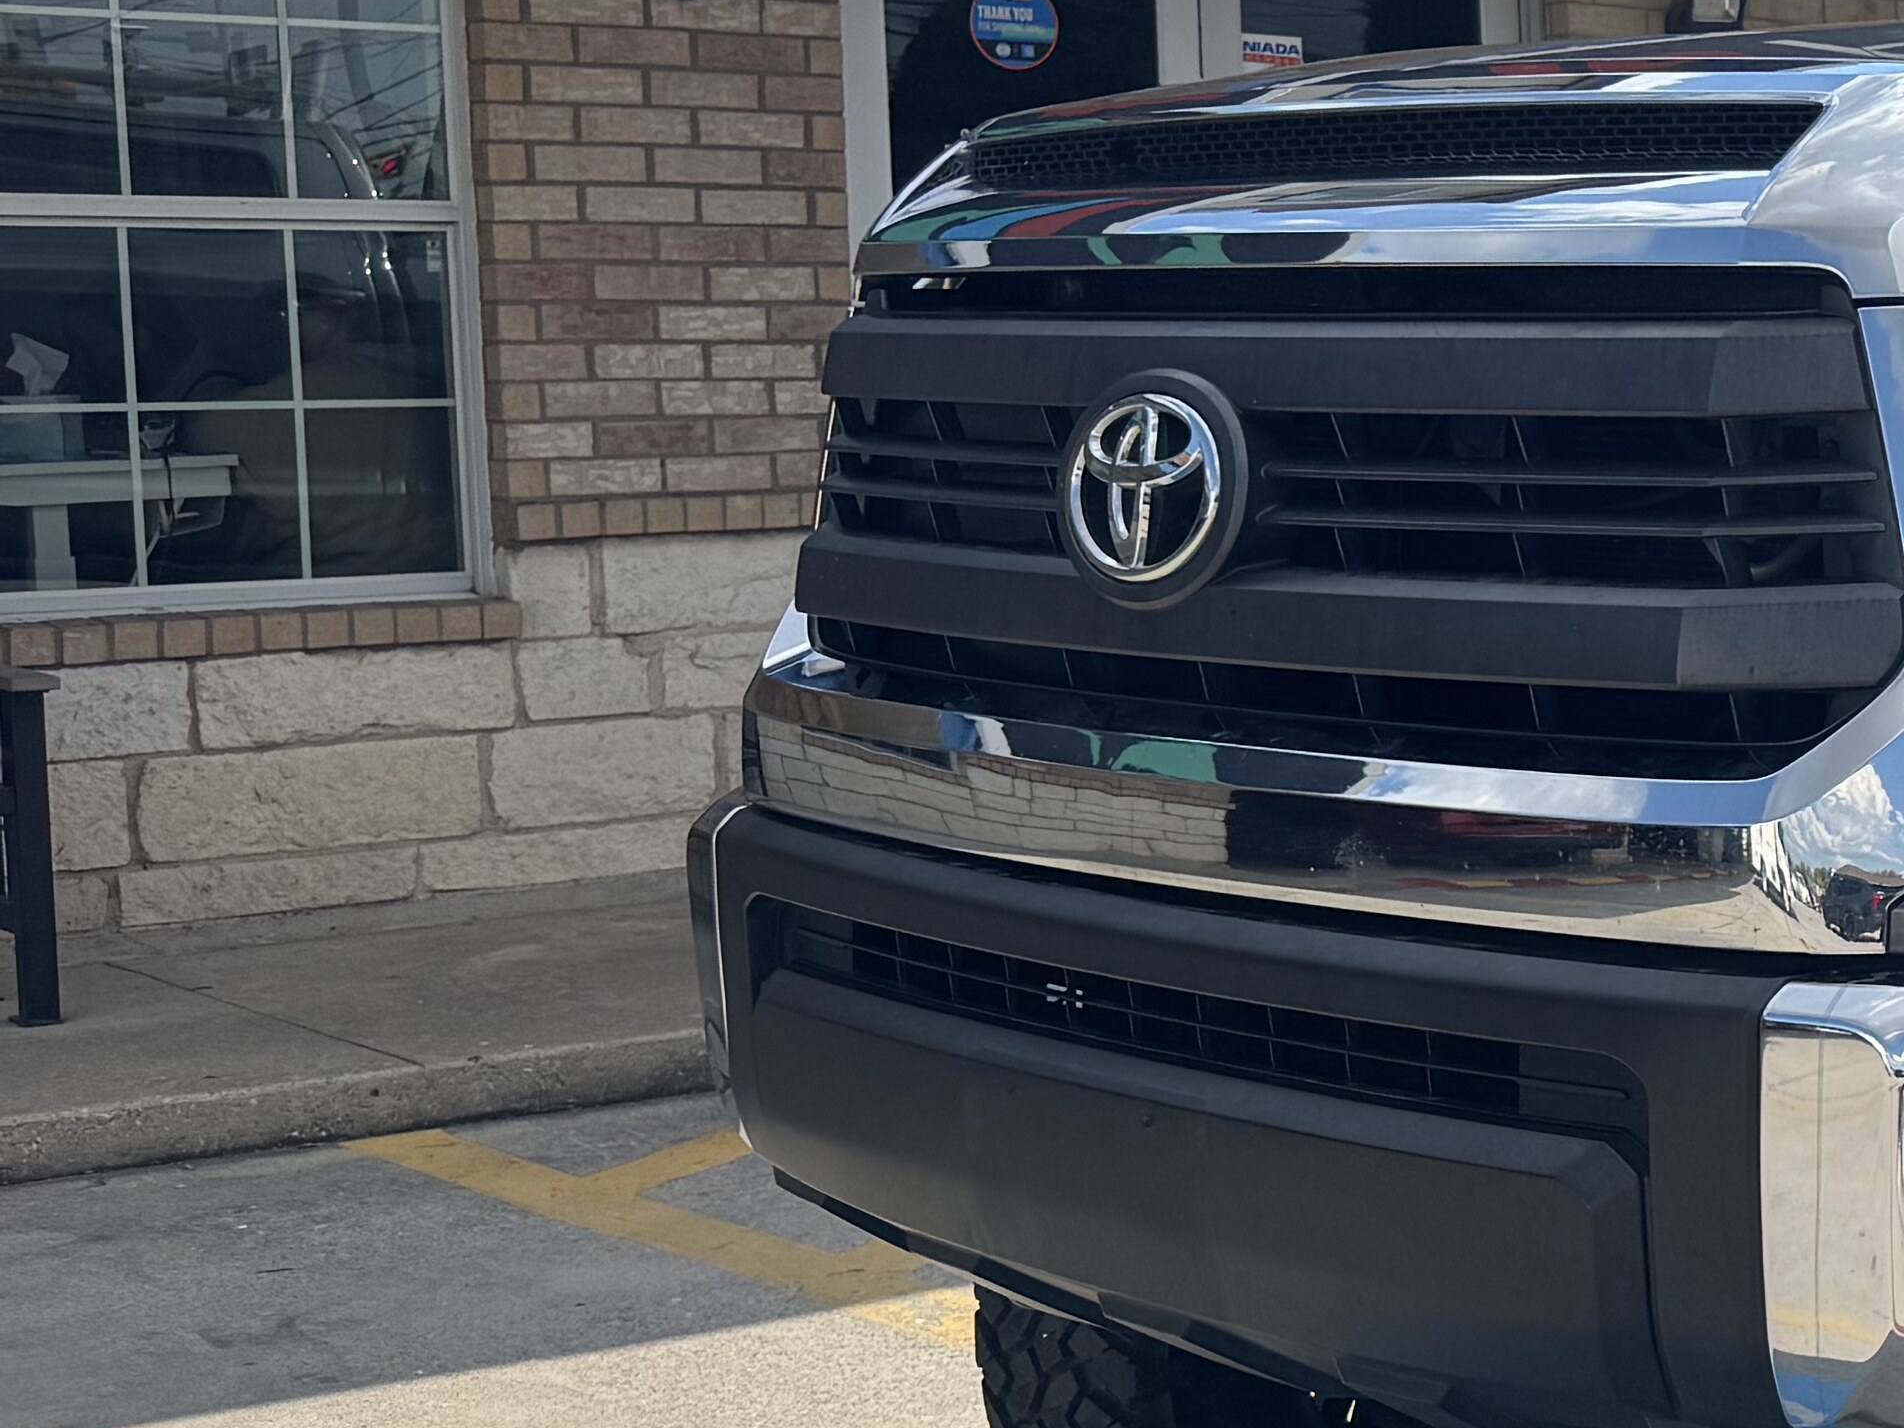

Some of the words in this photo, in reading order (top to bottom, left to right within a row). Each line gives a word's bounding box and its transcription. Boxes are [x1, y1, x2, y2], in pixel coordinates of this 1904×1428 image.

[977, 5, 1011, 20] THANK
[1012, 7, 1033, 22] YOU
[1243, 41, 1299, 55] NIADA
